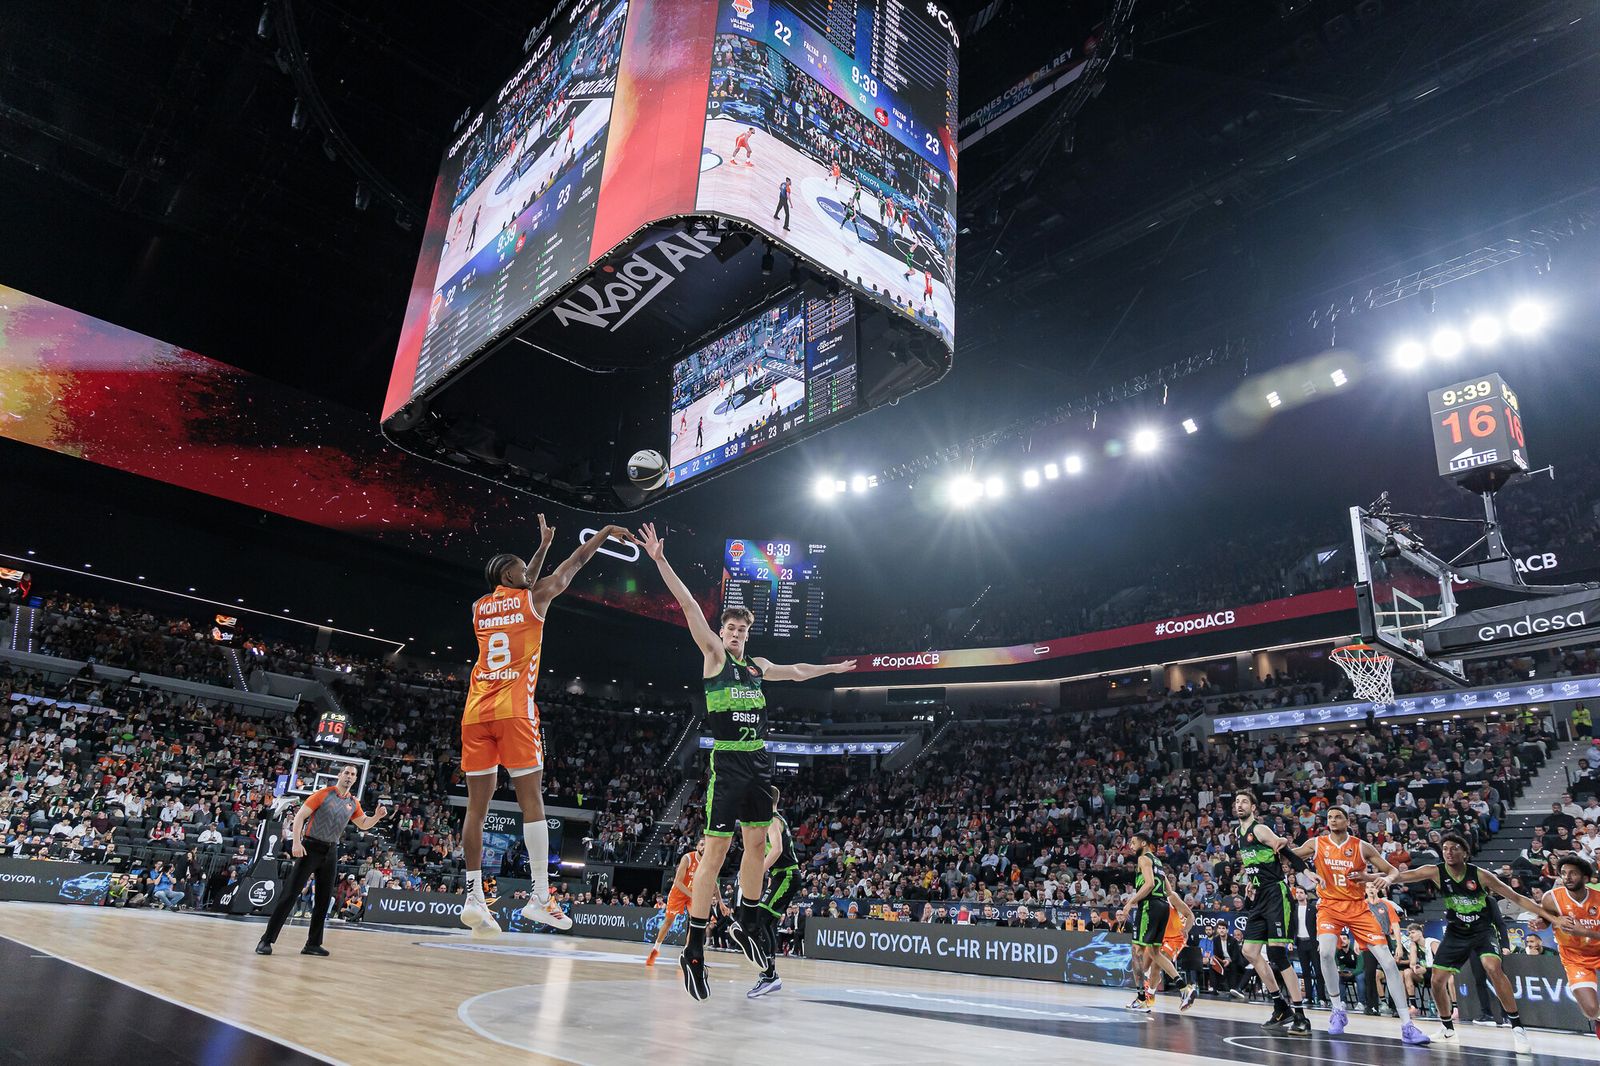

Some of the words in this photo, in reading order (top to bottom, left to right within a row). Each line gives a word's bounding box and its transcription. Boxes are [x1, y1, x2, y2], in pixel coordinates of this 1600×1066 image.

[730, 18, 755, 29] VALENCIA
[733, 24, 753, 33] BASKET
[774, 20, 792, 46] 22
[822, 54, 828, 64] 0
[498, 35, 552, 103] #CopaACB
[1003, 77, 1031, 100] COPA
[1032, 65, 1052, 82] DEL
[1053, 48, 1073, 68] REY
[851, 66, 878, 97] 9:39
[925, 133, 940, 155] 23
[557, 184, 571, 210] 23
[496, 223, 517, 253] 9:39
[445, 285, 456, 307] 22
[1442, 381, 1491, 406] 9:39
[1441, 404, 1497, 444] 16
[1505, 406, 1524, 448] 16
[692, 460, 700, 472] 22
[724, 443, 739, 458] 9:39
[768, 426, 777, 439] 23
[1449, 452, 1498, 471] LOTUS
[766, 543, 791, 556] 9:39
[756, 568, 769, 580] 22
[780, 569, 793, 581] 23
[479, 597, 520, 616] MONTERO
[478, 613, 525, 630] PAMESA
[1154, 610, 1236, 636] #CopaACB
[1478, 611, 1587, 641] endesa
[487, 632, 511, 670] 8
[872, 653, 940, 668] #CopaACB
[330, 713, 346, 721] 9:39
[327, 721, 343, 734] 16
[483, 822, 504, 832] C-HR
[484, 815, 516, 826] TOYOTA
[1323, 858, 1354, 869] VALENCIA
[0, 873, 36, 884] TOYOTA
[1333, 873, 1347, 887] 12
[380, 898, 426, 913] NUEVO
[429, 902, 464, 916] TOYO
[598, 914, 626, 928] TOYOTA
[816, 928, 867, 949] NUEVO
[870, 931, 932, 955] TOYOTA
[936, 937, 981, 959] C-HR
[985, 940, 1059, 965] HYBRID
[1486, 975, 1578, 1003] UEV
